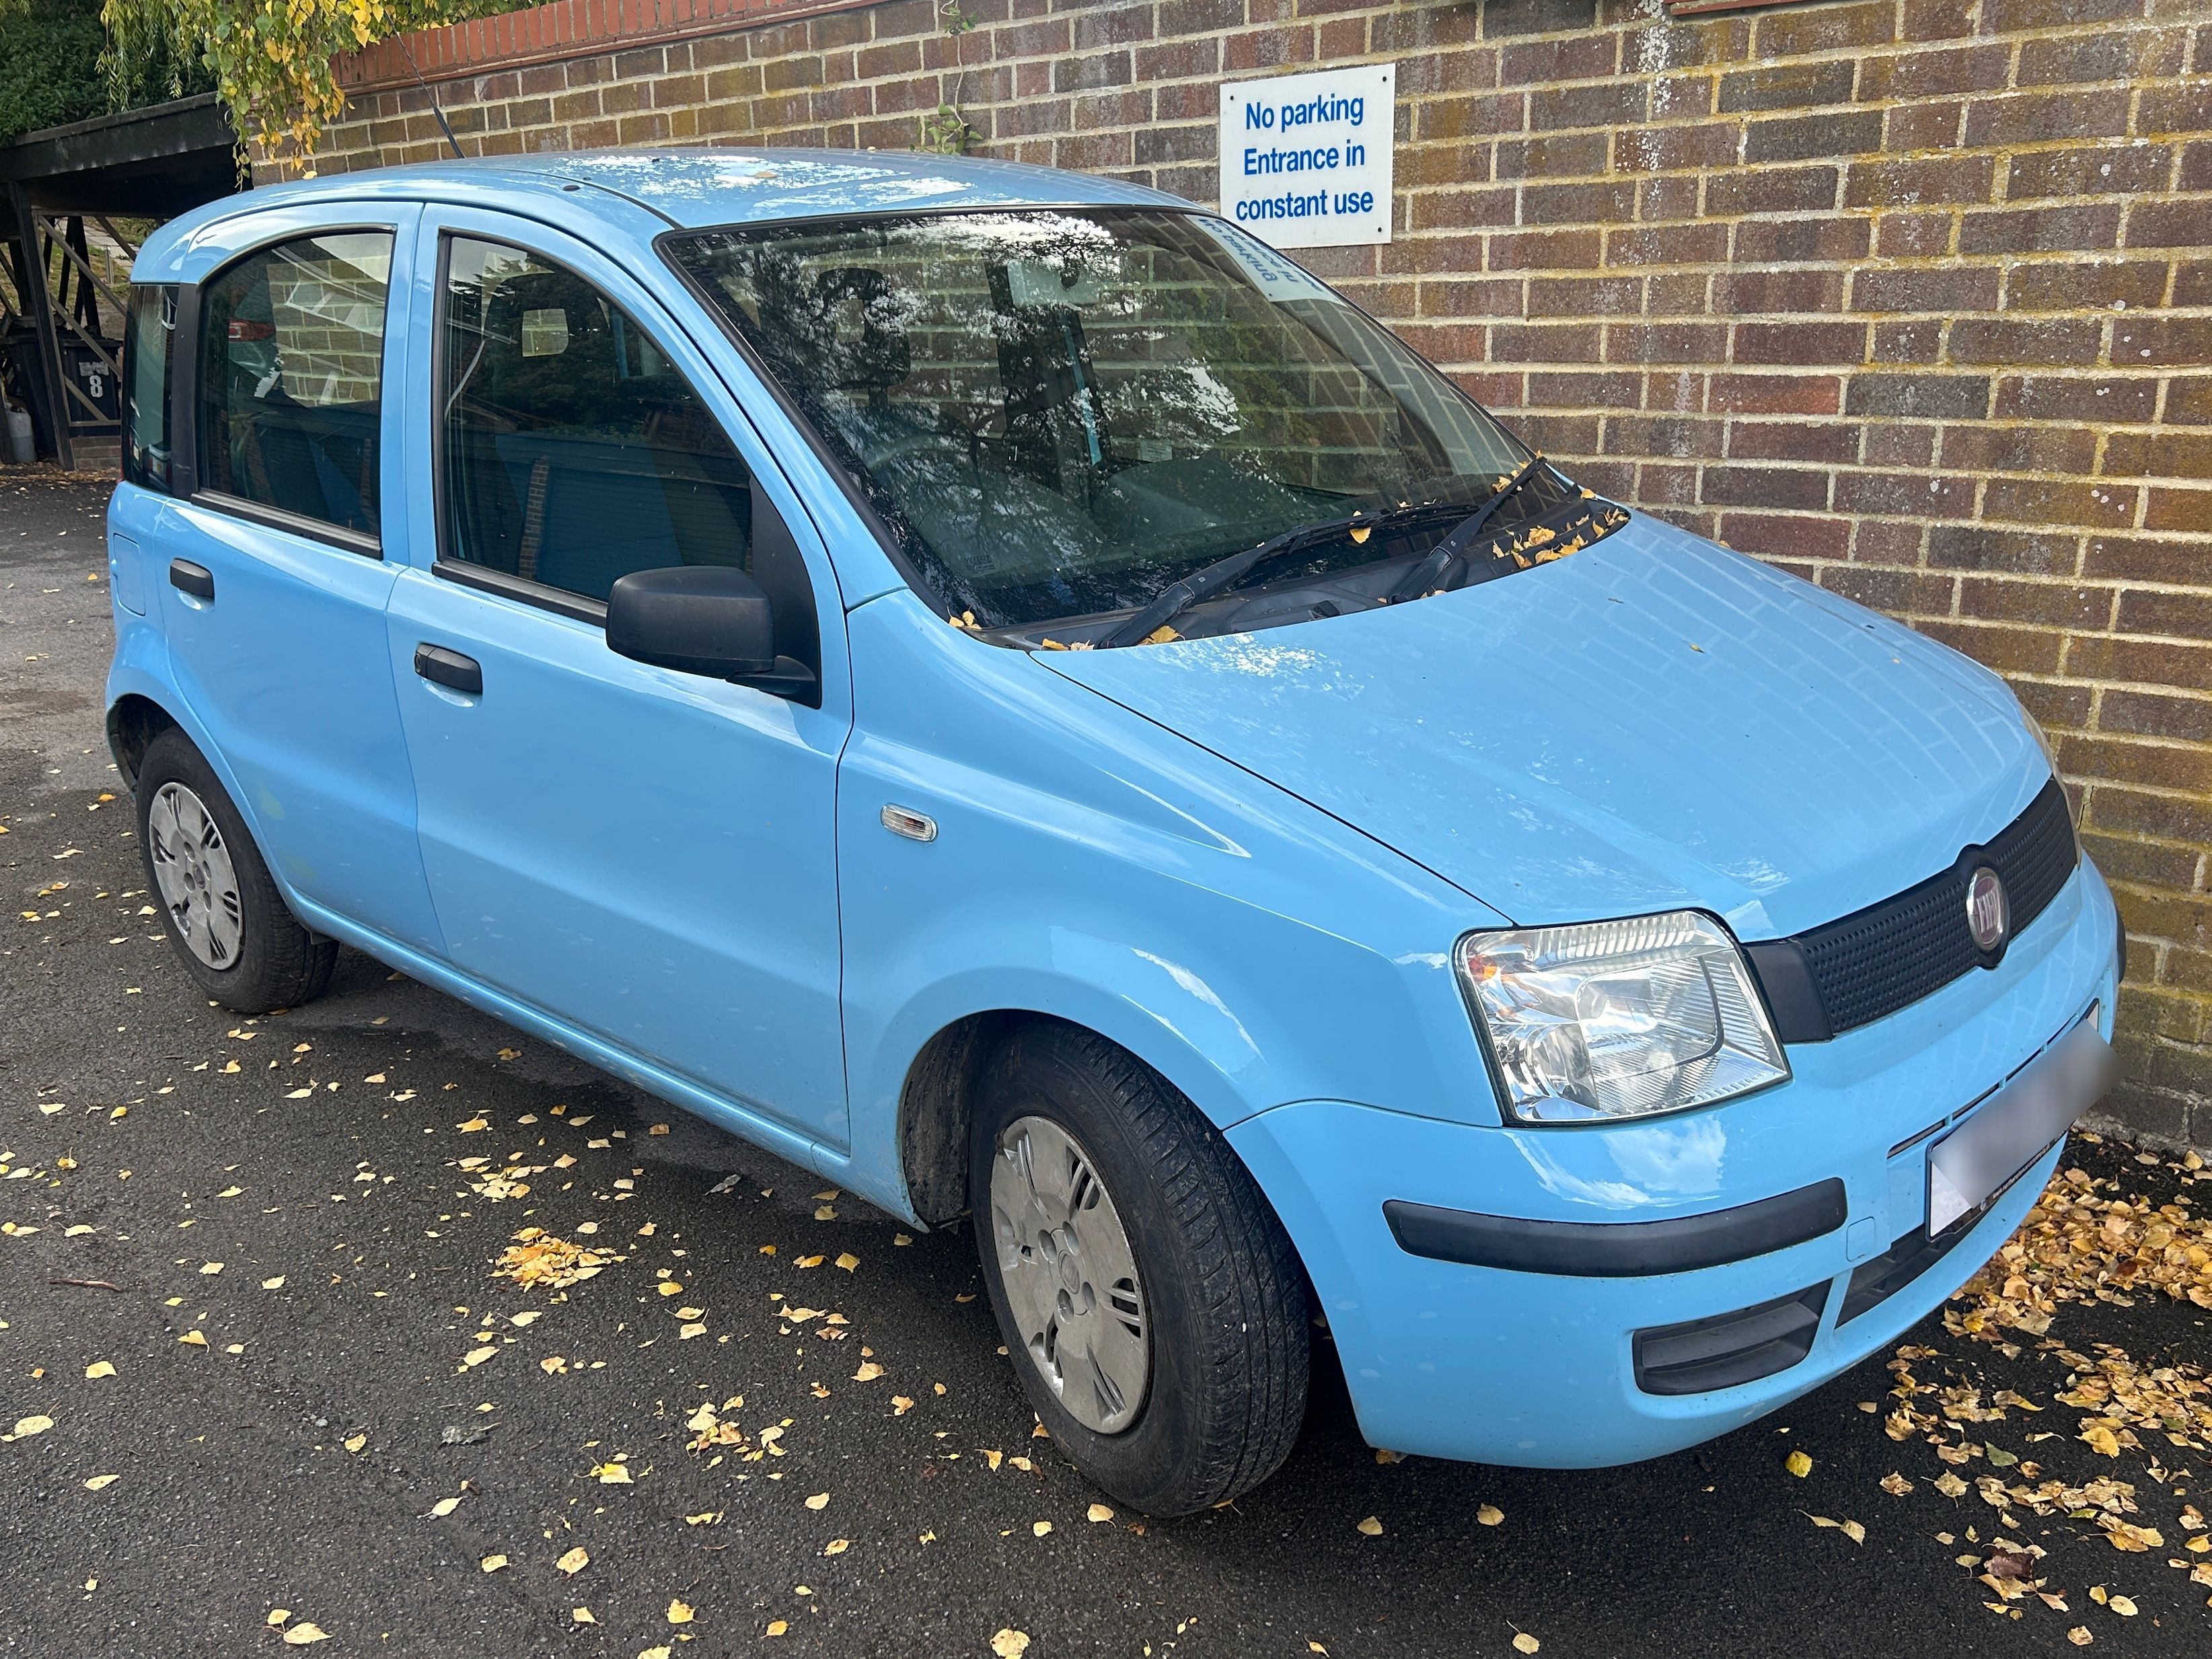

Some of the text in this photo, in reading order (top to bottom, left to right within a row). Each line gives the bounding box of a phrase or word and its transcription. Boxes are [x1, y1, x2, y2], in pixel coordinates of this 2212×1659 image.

[1246, 93, 1364, 133] No parking
[1245, 139, 1364, 176] Entrance in
[1236, 190, 1373, 221] constant use
[89, 375, 103, 398] 8
